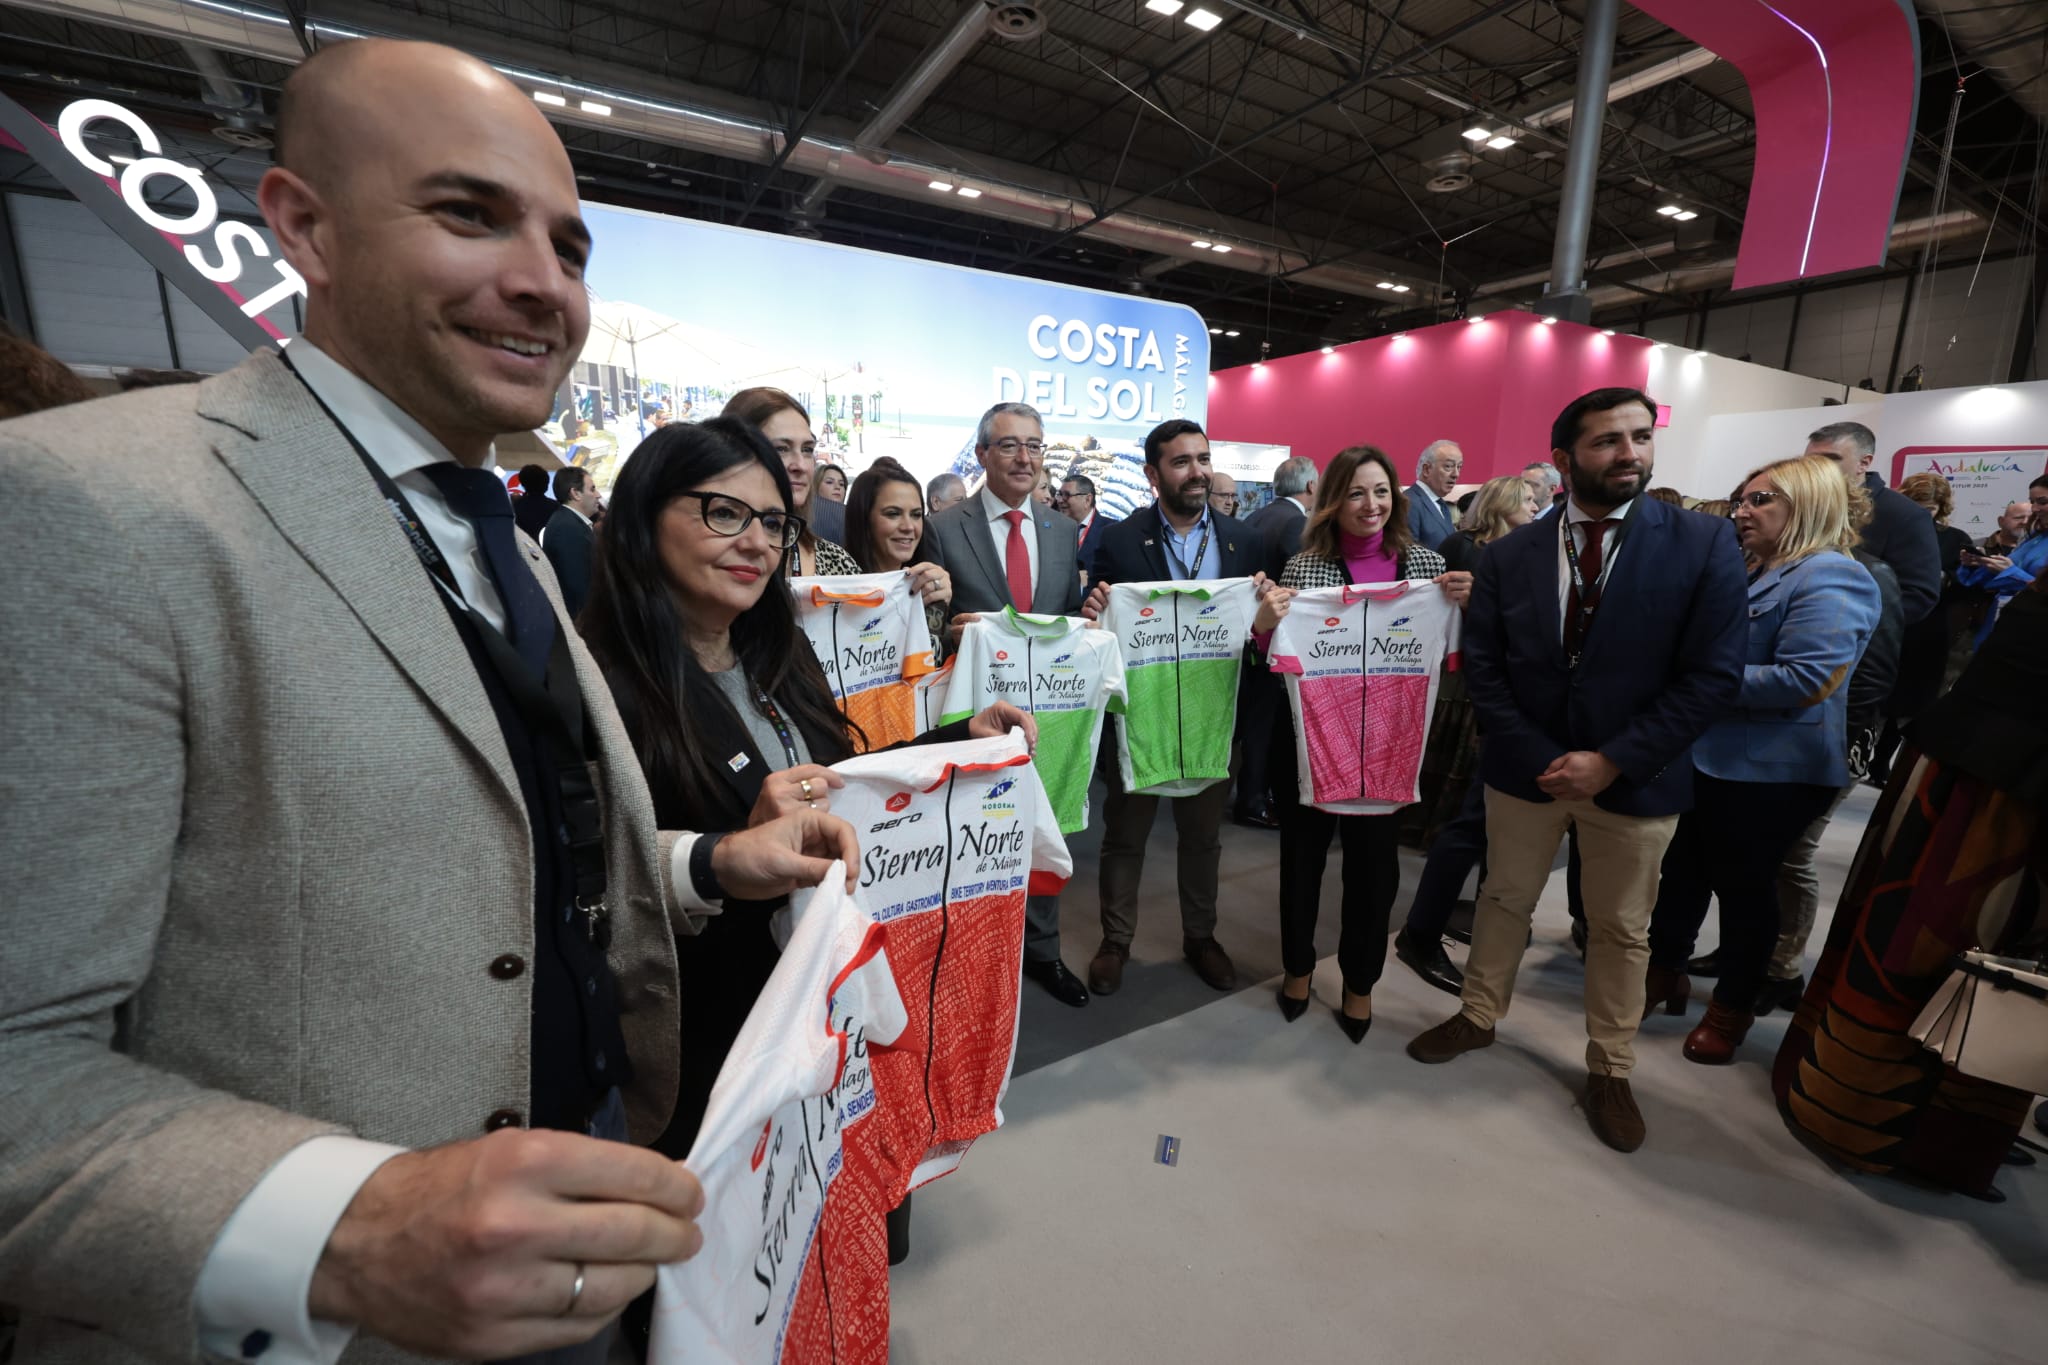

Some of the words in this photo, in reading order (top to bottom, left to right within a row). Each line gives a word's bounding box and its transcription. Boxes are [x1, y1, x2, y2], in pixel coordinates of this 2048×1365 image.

[1027, 314, 1165, 372] COSTA
[992, 366, 1077, 417] DEL
[1086, 376, 1163, 422] SOL
[1927, 456, 2024, 475] Andalucía
[1129, 631, 1174, 649] Sierra
[1182, 624, 1229, 642] Norte
[1317, 627, 1348, 635] aero
[844, 640, 896, 670] Norte
[1309, 640, 1361, 659] Sierra
[1370, 637, 1422, 655] Norte
[1383, 655, 1391, 663] de
[985, 673, 1027, 693] Sierra
[1035, 673, 1085, 692] Norte
[870, 813, 922, 833] aero
[861, 845, 944, 887] Sierra
[957, 820, 1023, 861] Norte
[976, 857, 986, 874] de
